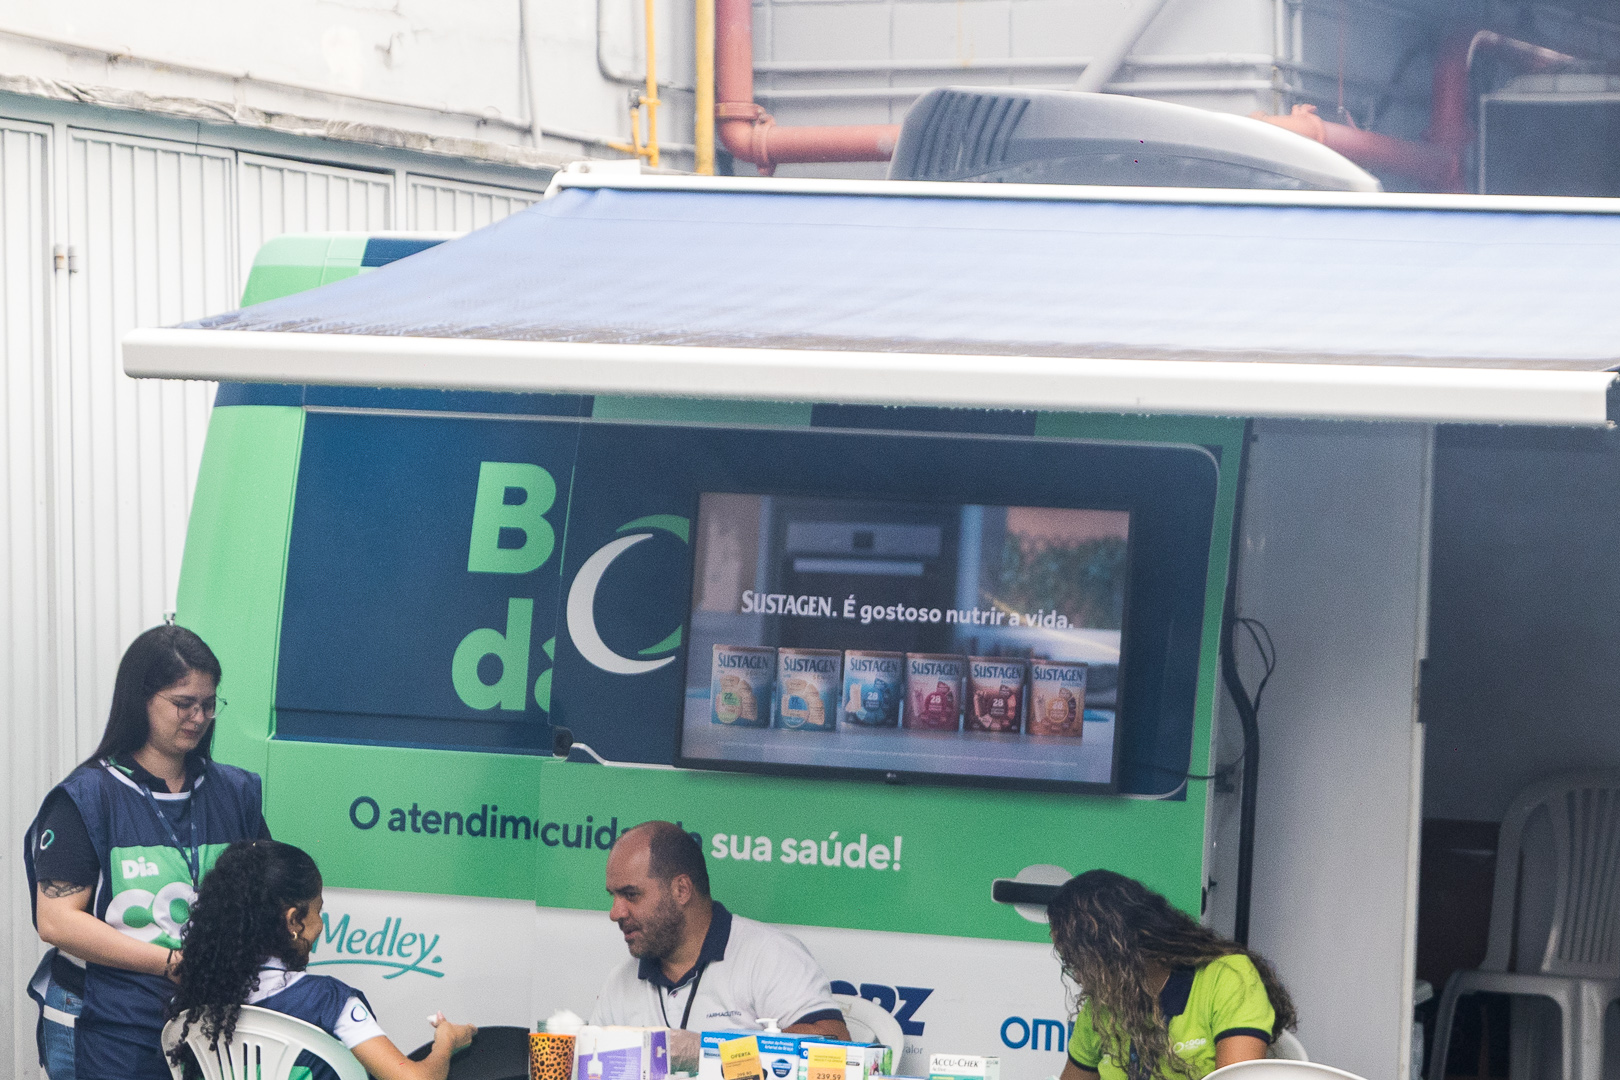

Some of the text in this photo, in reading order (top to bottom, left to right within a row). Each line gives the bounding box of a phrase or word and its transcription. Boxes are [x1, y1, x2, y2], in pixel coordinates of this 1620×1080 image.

[843, 595, 856, 618] É
[860, 602, 942, 624] gostoso
[946, 607, 1006, 625] nutrir
[1008, 612, 1020, 626] a
[1025, 609, 1074, 629] vida.
[349, 796, 380, 830] O
[387, 803, 539, 840] atendim
[541, 815, 632, 850] cuid
[711, 833, 773, 862] sua
[780, 831, 903, 871] saúde!
[121, 856, 159, 879] Dia
